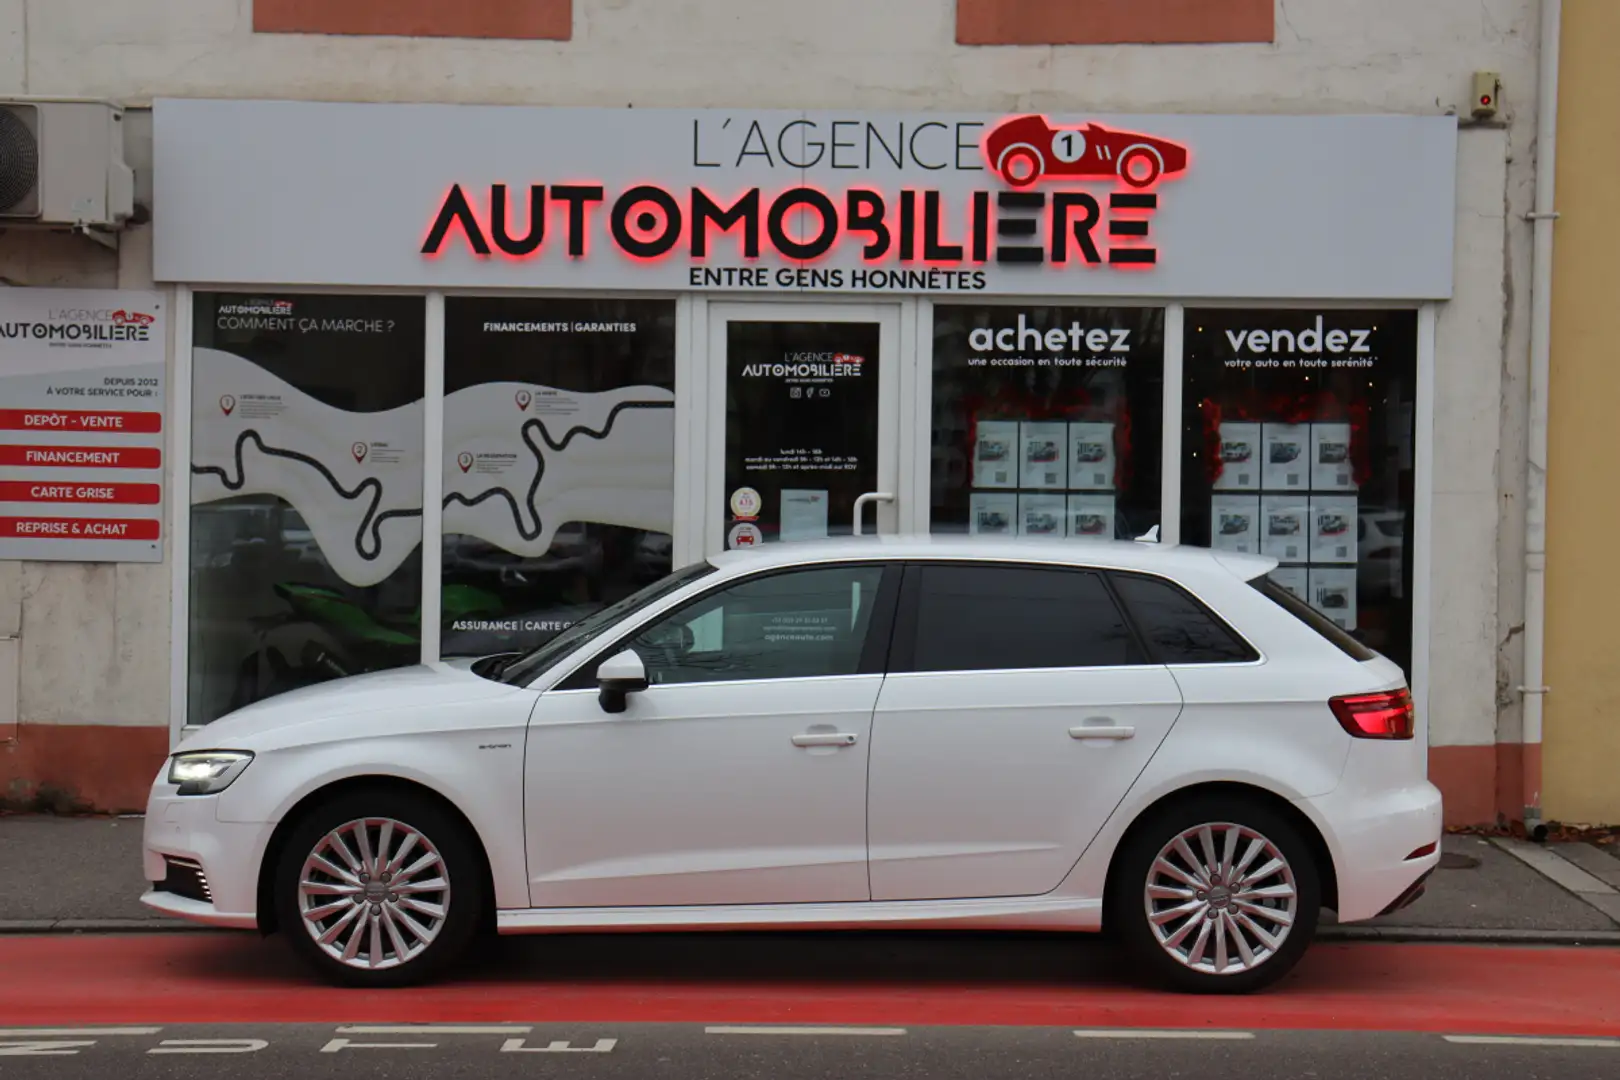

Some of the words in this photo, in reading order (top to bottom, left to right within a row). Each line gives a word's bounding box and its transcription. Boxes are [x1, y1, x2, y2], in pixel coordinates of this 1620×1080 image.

[692, 118, 984, 171] L'AGENCE
[689, 267, 768, 286] ENTRE
[775, 268, 844, 288] GENS
[851, 266, 986, 290] HONNÊTES
[48, 309, 112, 322] L'AGENCE
[217, 316, 296, 330] COMMENT
[299, 318, 318, 333] ÇA
[321, 319, 383, 332] MARCHE
[483, 322, 569, 332] FINANCEMENTS
[574, 323, 637, 333] GARANTIES
[968, 313, 1131, 352] achetez
[1225, 315, 1371, 353] vendez
[784, 352, 833, 362] L'AGENCE
[968, 358, 987, 366] une
[990, 356, 1034, 366] occasion
[1038, 358, 1050, 366] en
[1054, 357, 1082, 366] toute
[1085, 355, 1127, 367] sécurité
[1224, 358, 1252, 367] votre
[1255, 358, 1280, 367] auto
[1299, 358, 1327, 367] toute
[104, 377, 135, 386] DEPUIS
[137, 378, 158, 386] 2012
[46, 385, 53, 395] À
[55, 387, 85, 396] VOTRE
[88, 388, 124, 397] SERVICE
[126, 388, 153, 397] POUR
[24, 413, 67, 426] DEPÔT
[80, 416, 123, 428] VENTE
[26, 451, 120, 464] FINANCEMENT
[31, 486, 73, 498] CARTE
[76, 487, 115, 499] GRISE
[16, 522, 68, 534] REPRISE
[71, 523, 80, 534] &
[84, 523, 128, 535] ACHAT
[452, 620, 518, 631] ASSURANCE
[525, 620, 561, 631] CARTE
